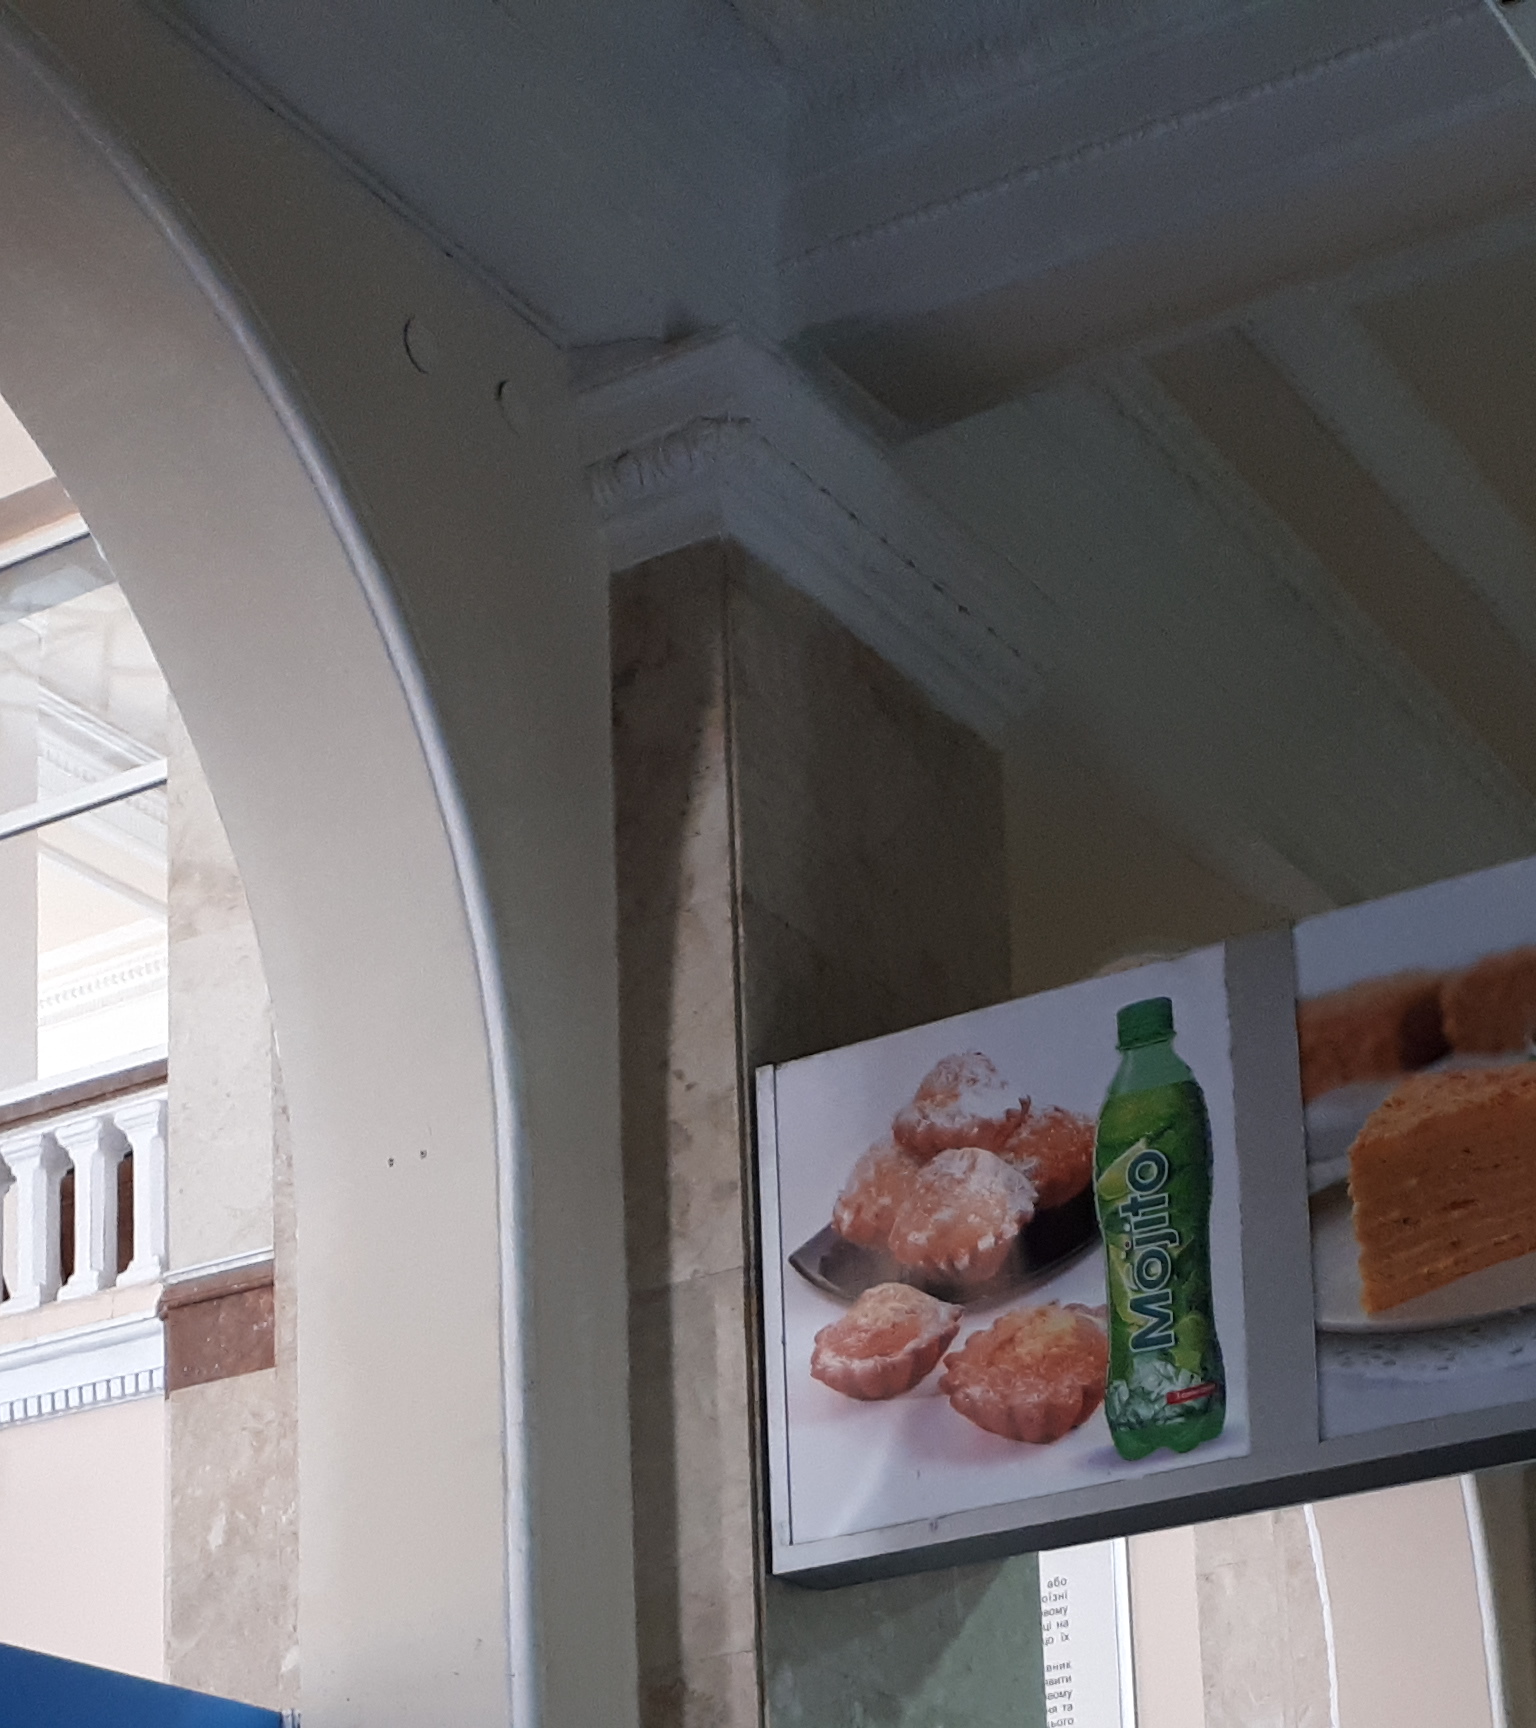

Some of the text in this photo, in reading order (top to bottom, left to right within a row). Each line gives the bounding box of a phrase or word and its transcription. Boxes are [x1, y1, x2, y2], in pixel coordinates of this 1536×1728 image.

[1047, 1576, 1068, 1589] або
[1041, 1605, 1069, 1617] вому
[1056, 1619, 1070, 1630] на
[1063, 1703, 1074, 1713] та
